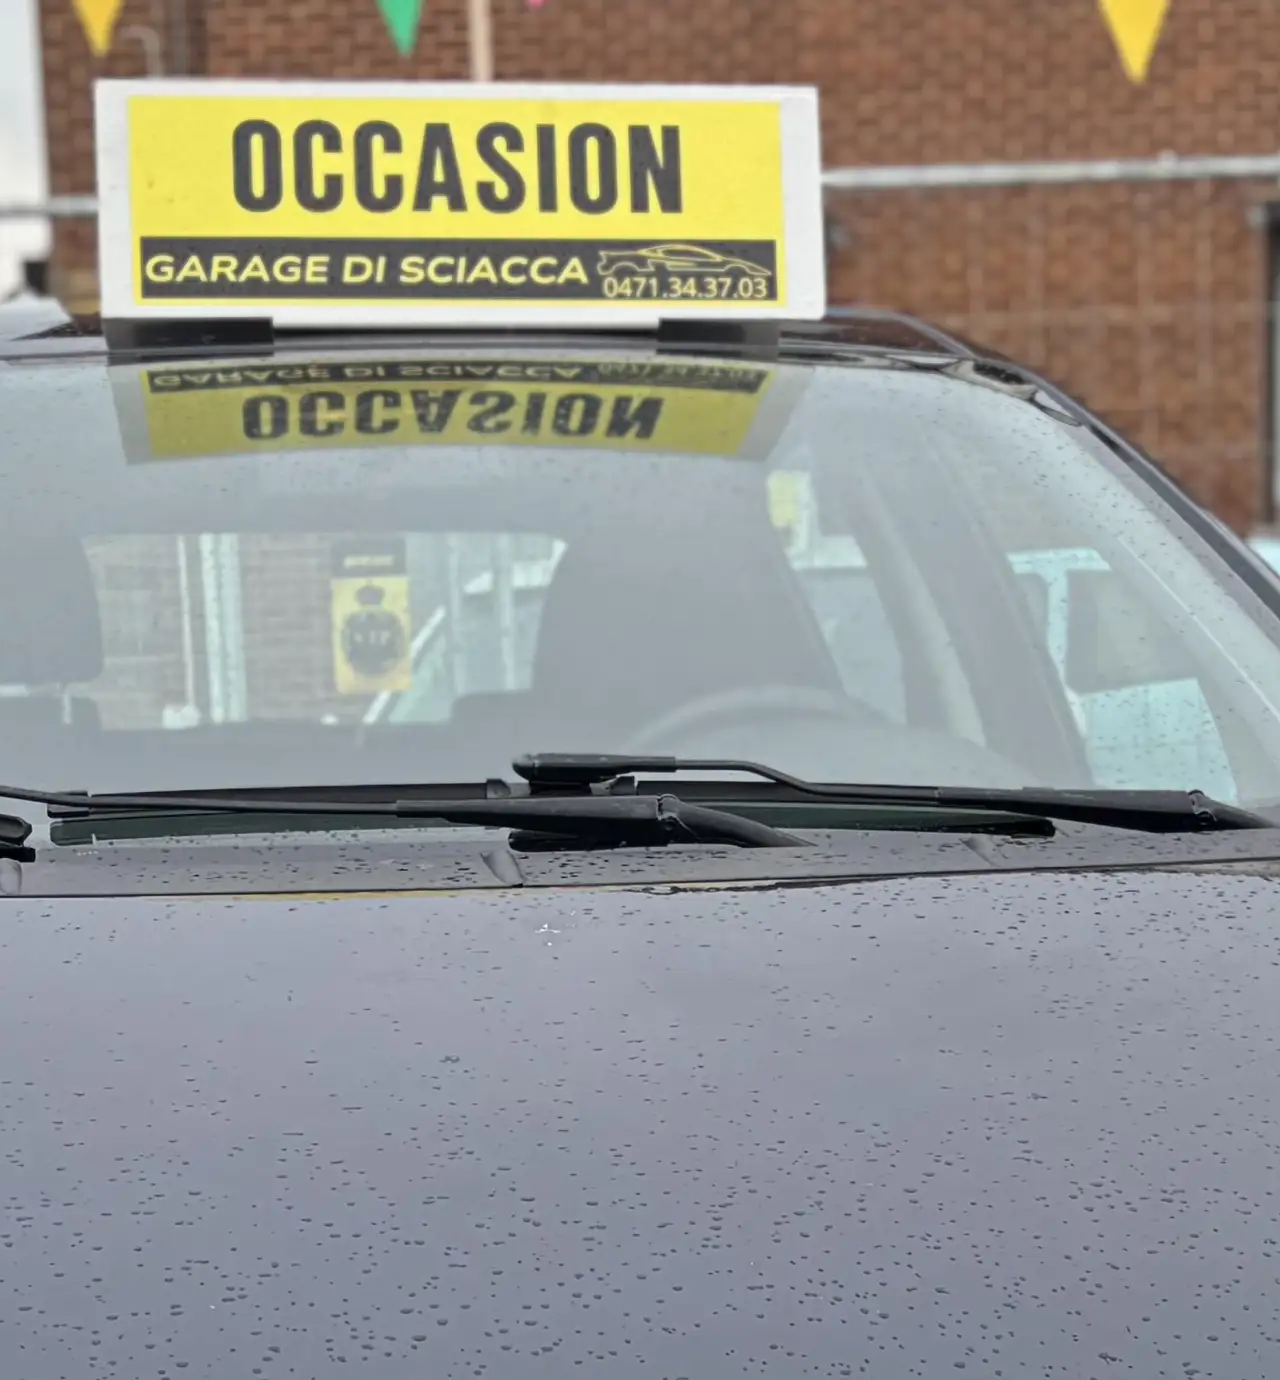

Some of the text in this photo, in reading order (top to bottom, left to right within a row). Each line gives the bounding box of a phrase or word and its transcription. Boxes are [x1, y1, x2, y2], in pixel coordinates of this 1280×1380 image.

[232, 119, 683, 214] OCCASION
[144, 253, 589, 285] GARAGE DI SCIACCA
[602, 276, 768, 299] 0471.34.37.03
